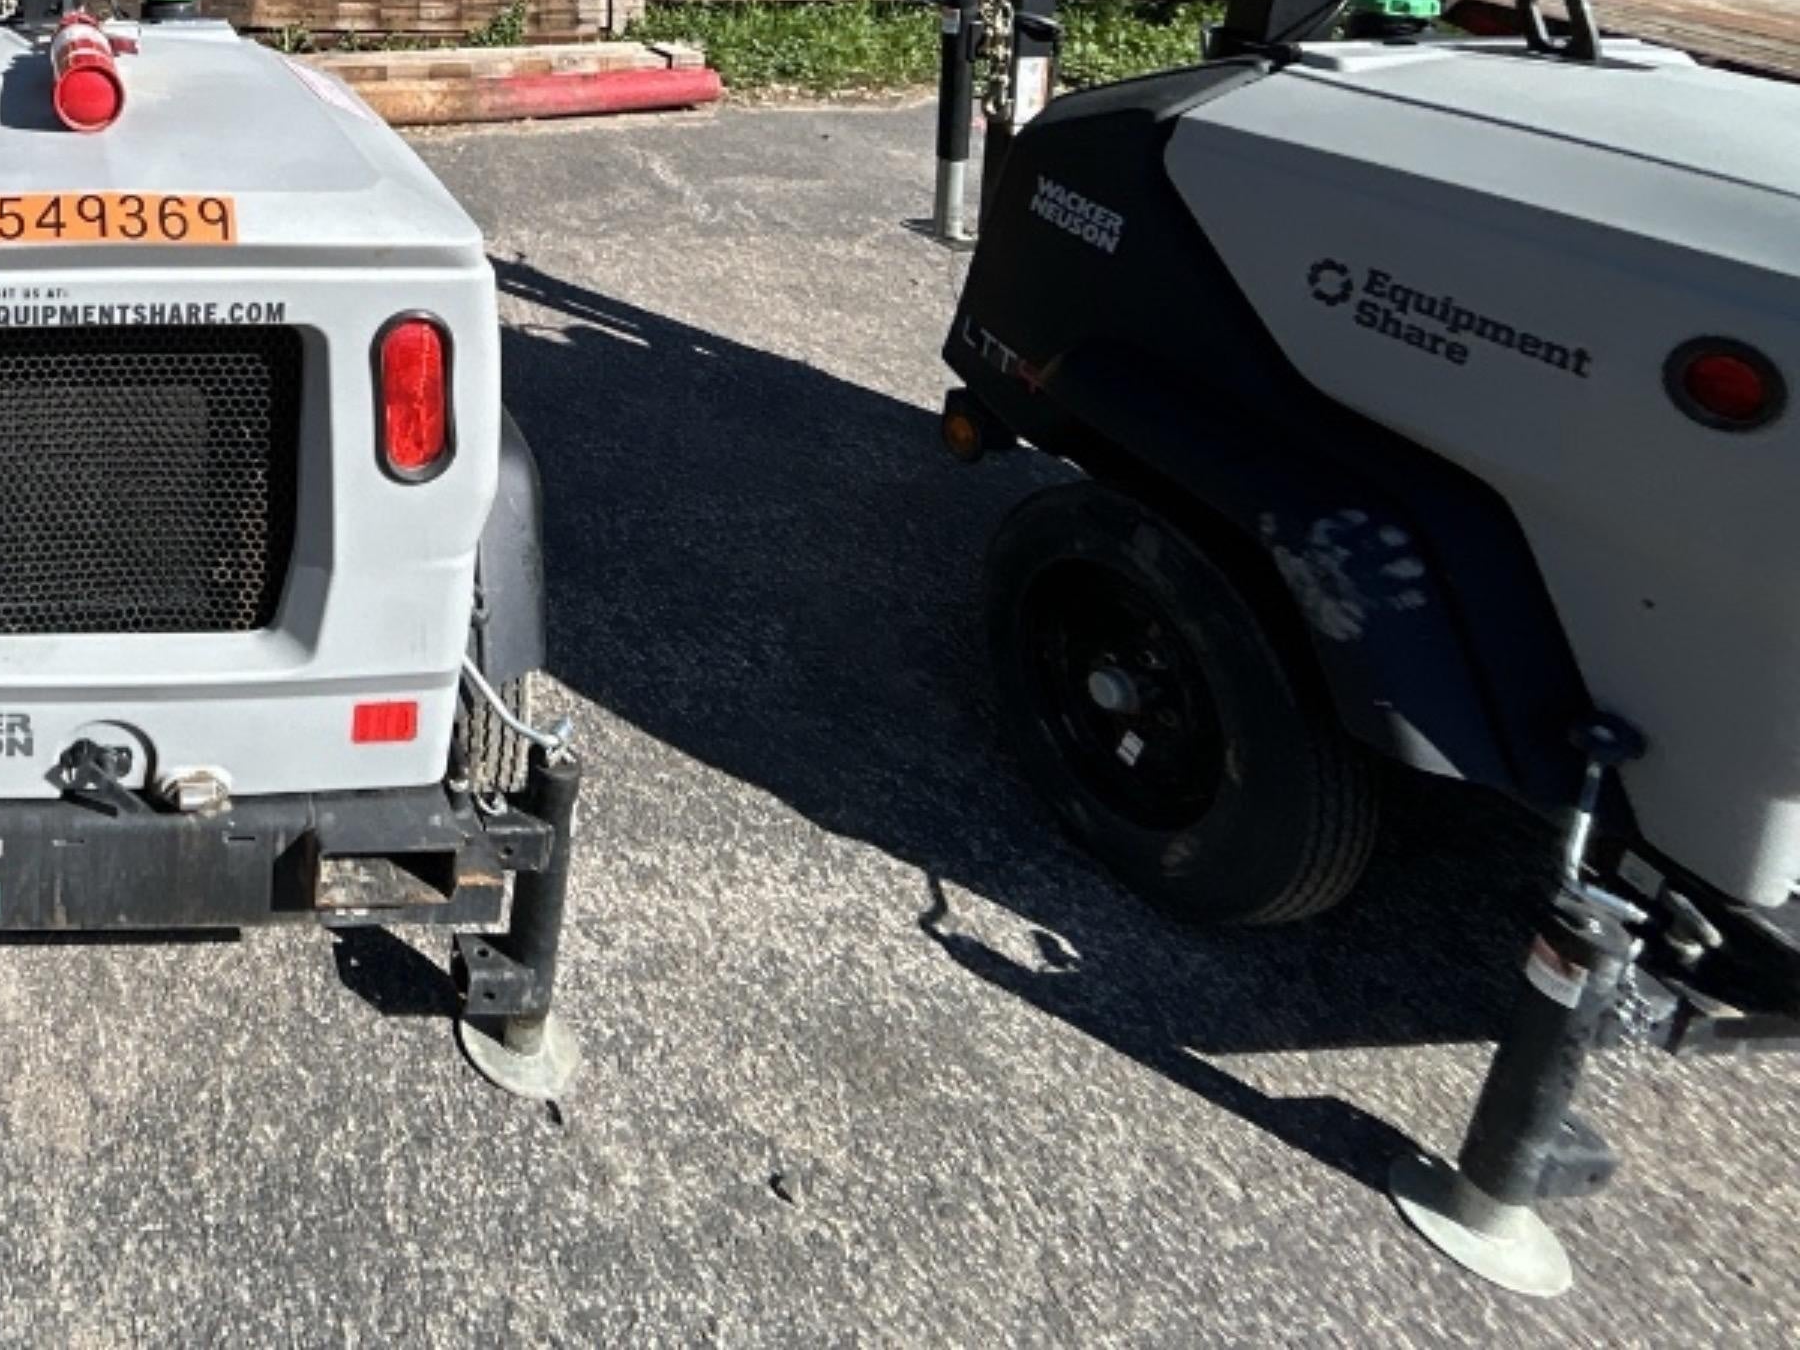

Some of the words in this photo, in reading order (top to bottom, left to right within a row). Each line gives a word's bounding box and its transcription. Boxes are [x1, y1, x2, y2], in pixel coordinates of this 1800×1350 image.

[1030, 194, 1121, 255] NEUSON
[1036, 174, 1124, 236] WACKER
[23, 287, 40, 299] US
[1361, 267, 1593, 379] Equipment
[1353, 299, 1470, 367] Share
